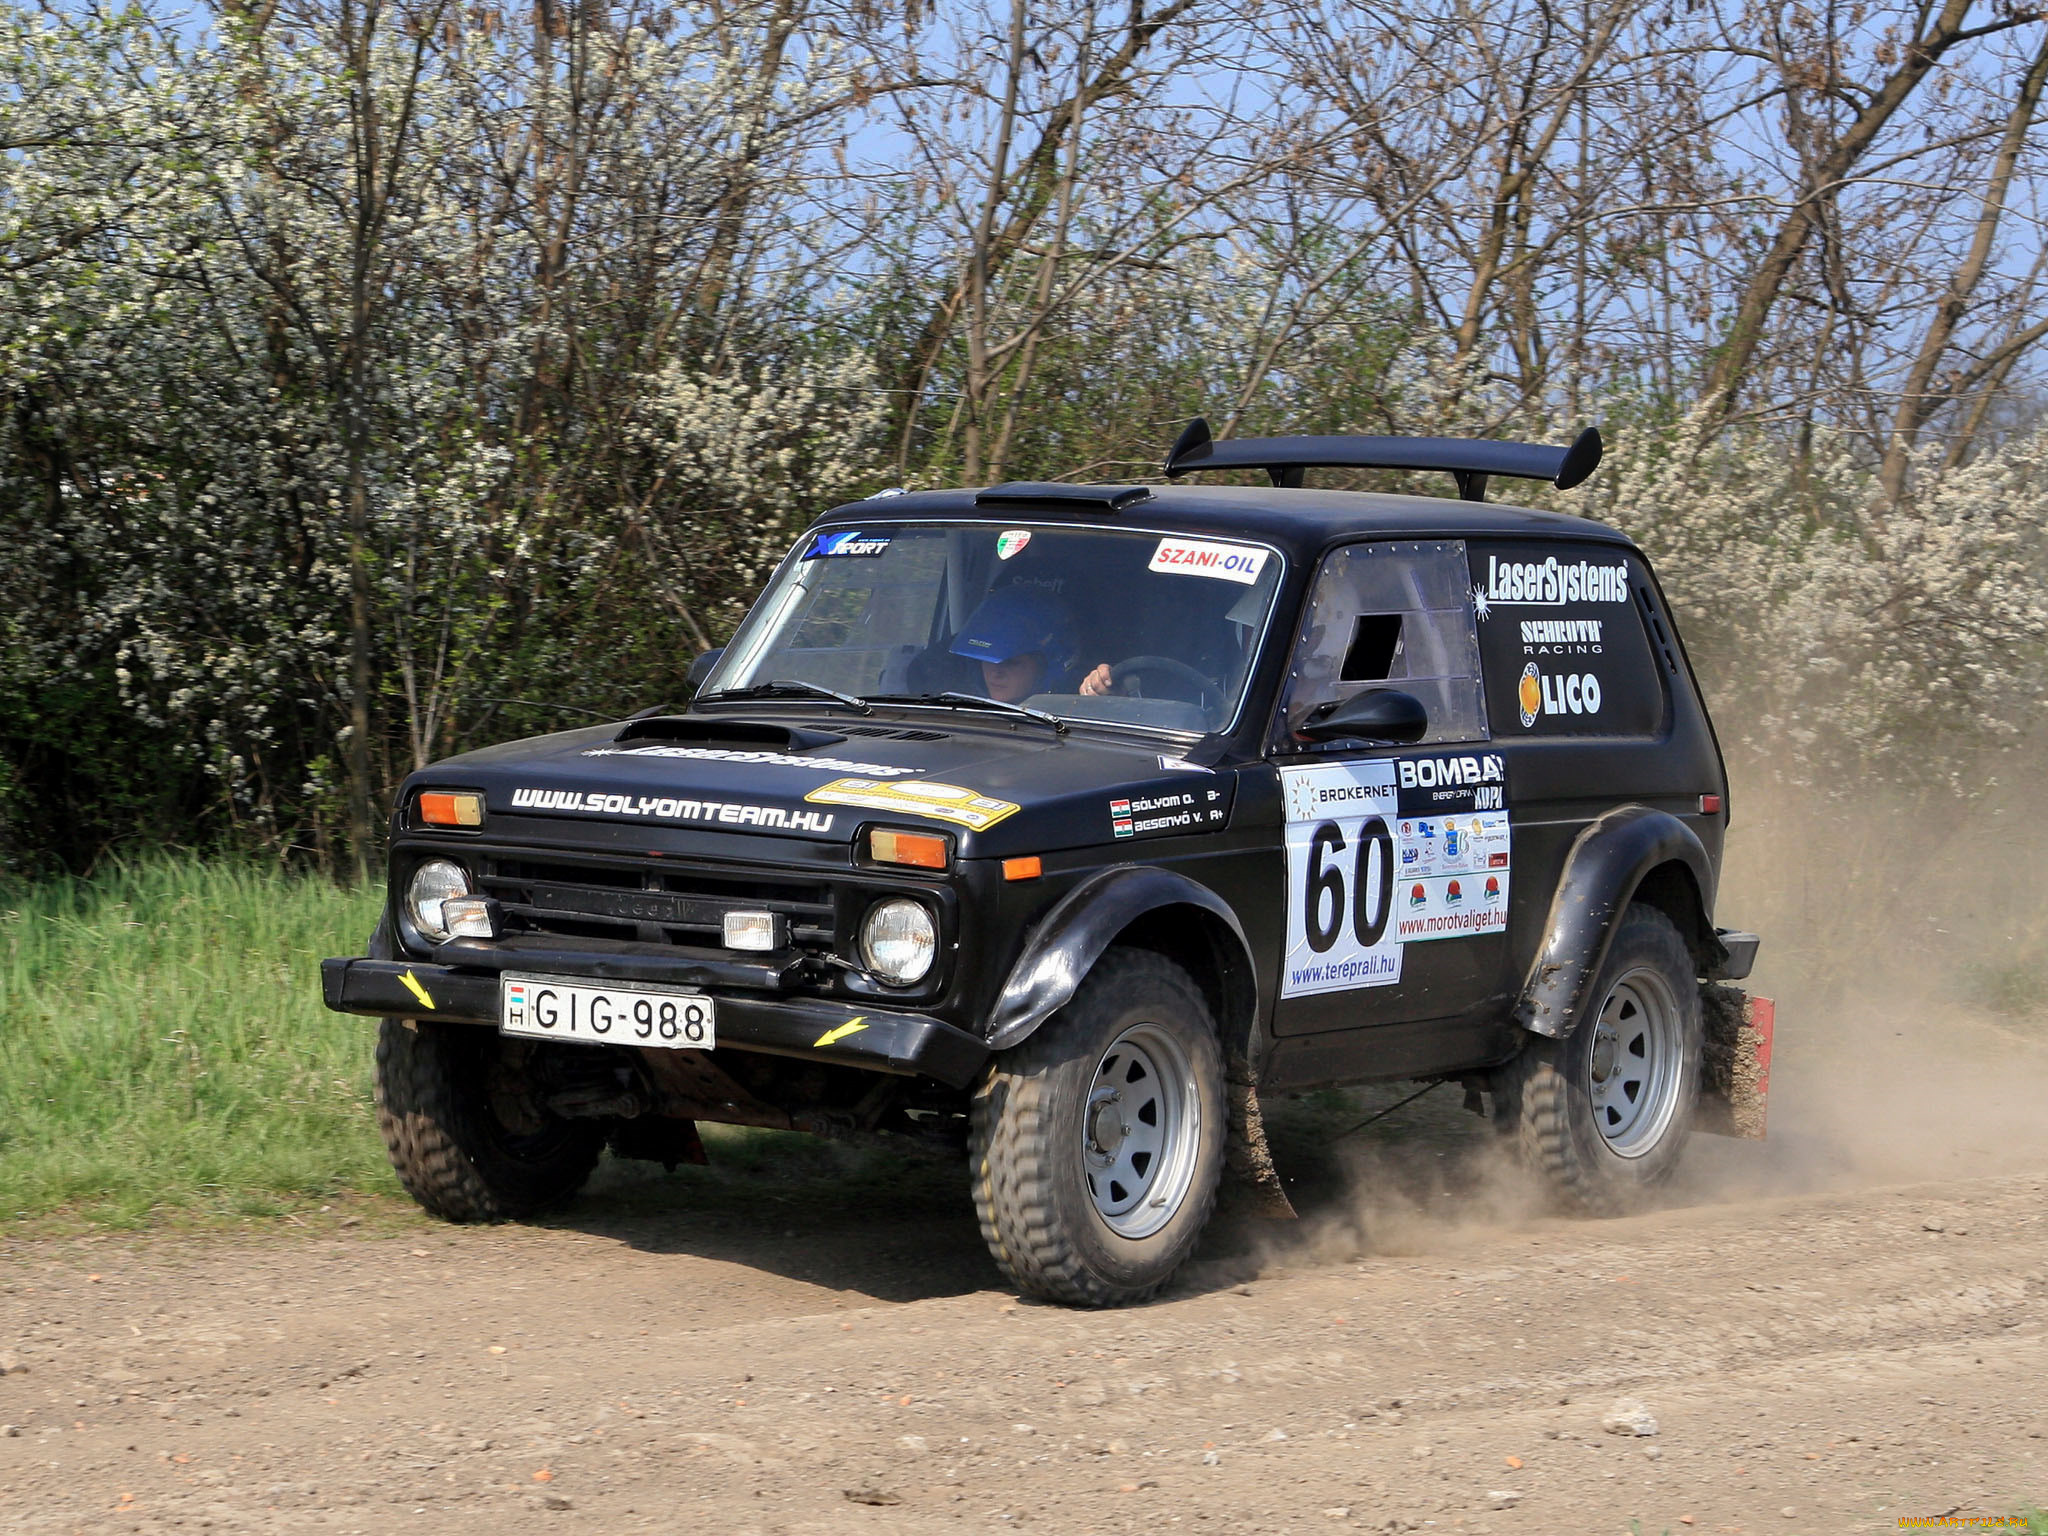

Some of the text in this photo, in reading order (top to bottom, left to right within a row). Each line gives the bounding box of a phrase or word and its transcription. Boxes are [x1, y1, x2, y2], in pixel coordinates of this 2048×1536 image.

[1157, 547, 1255, 574] SZANI-OIL
[1524, 645, 1603, 655] RACING
[1541, 673, 1601, 715] LICO
[1131, 795, 1180, 812] SÓLYOM
[1182, 793, 1194, 805] O.
[1320, 784, 1397, 802] BROKERNET
[512, 788, 834, 832] WWW.SOLYOMTEAM.HU
[1193, 812, 1203, 823] V.
[1305, 815, 1394, 953] 60
[1400, 907, 1507, 935] www.morotvaliget.hu
[1292, 954, 1395, 985] www.tereprali.hu
[509, 989, 704, 1041] H GIG-988
